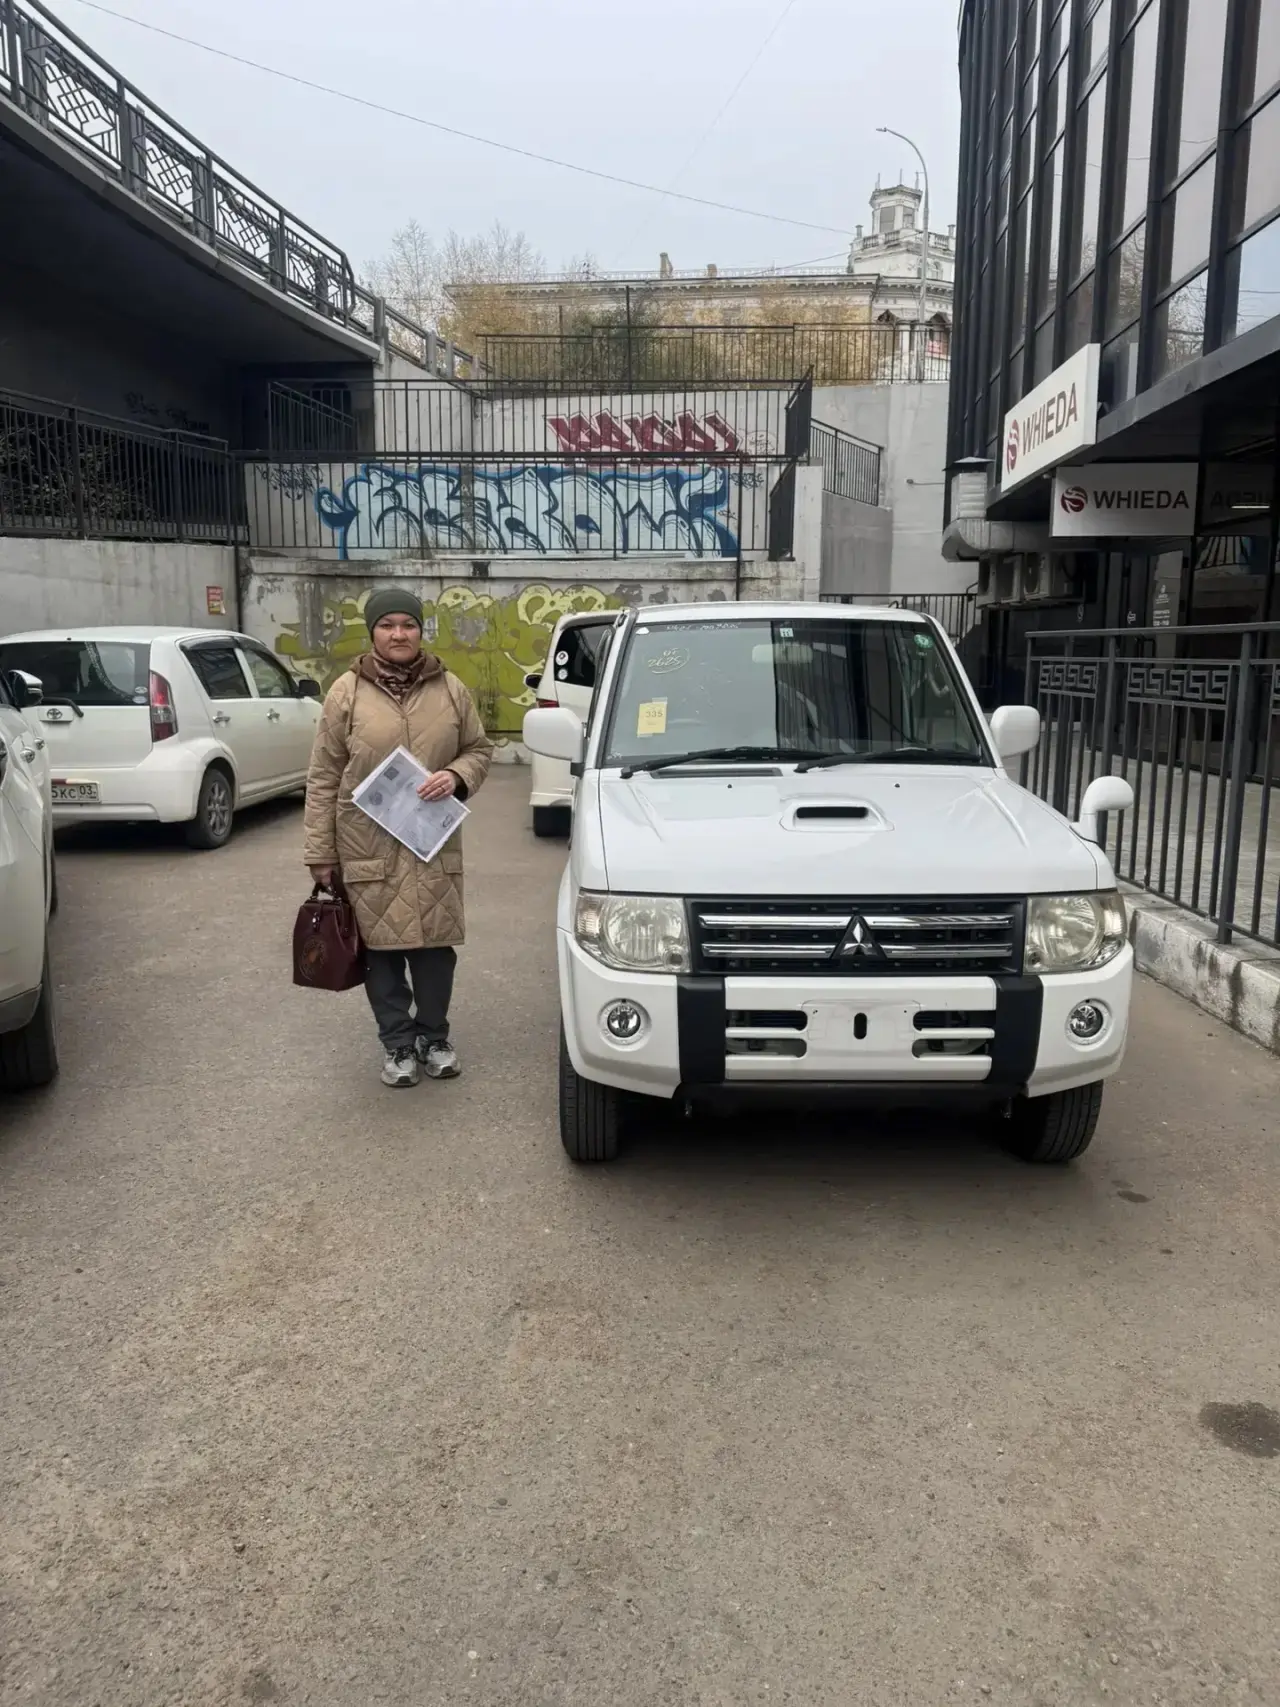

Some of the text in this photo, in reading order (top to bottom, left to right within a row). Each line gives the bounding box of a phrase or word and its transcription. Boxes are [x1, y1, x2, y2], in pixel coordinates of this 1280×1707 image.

[1023, 382, 1077, 456] WHIEDA
[1093, 490, 1190, 509] WHIEDA
[645, 710, 663, 718] 335
[79, 785, 92, 795] 03
